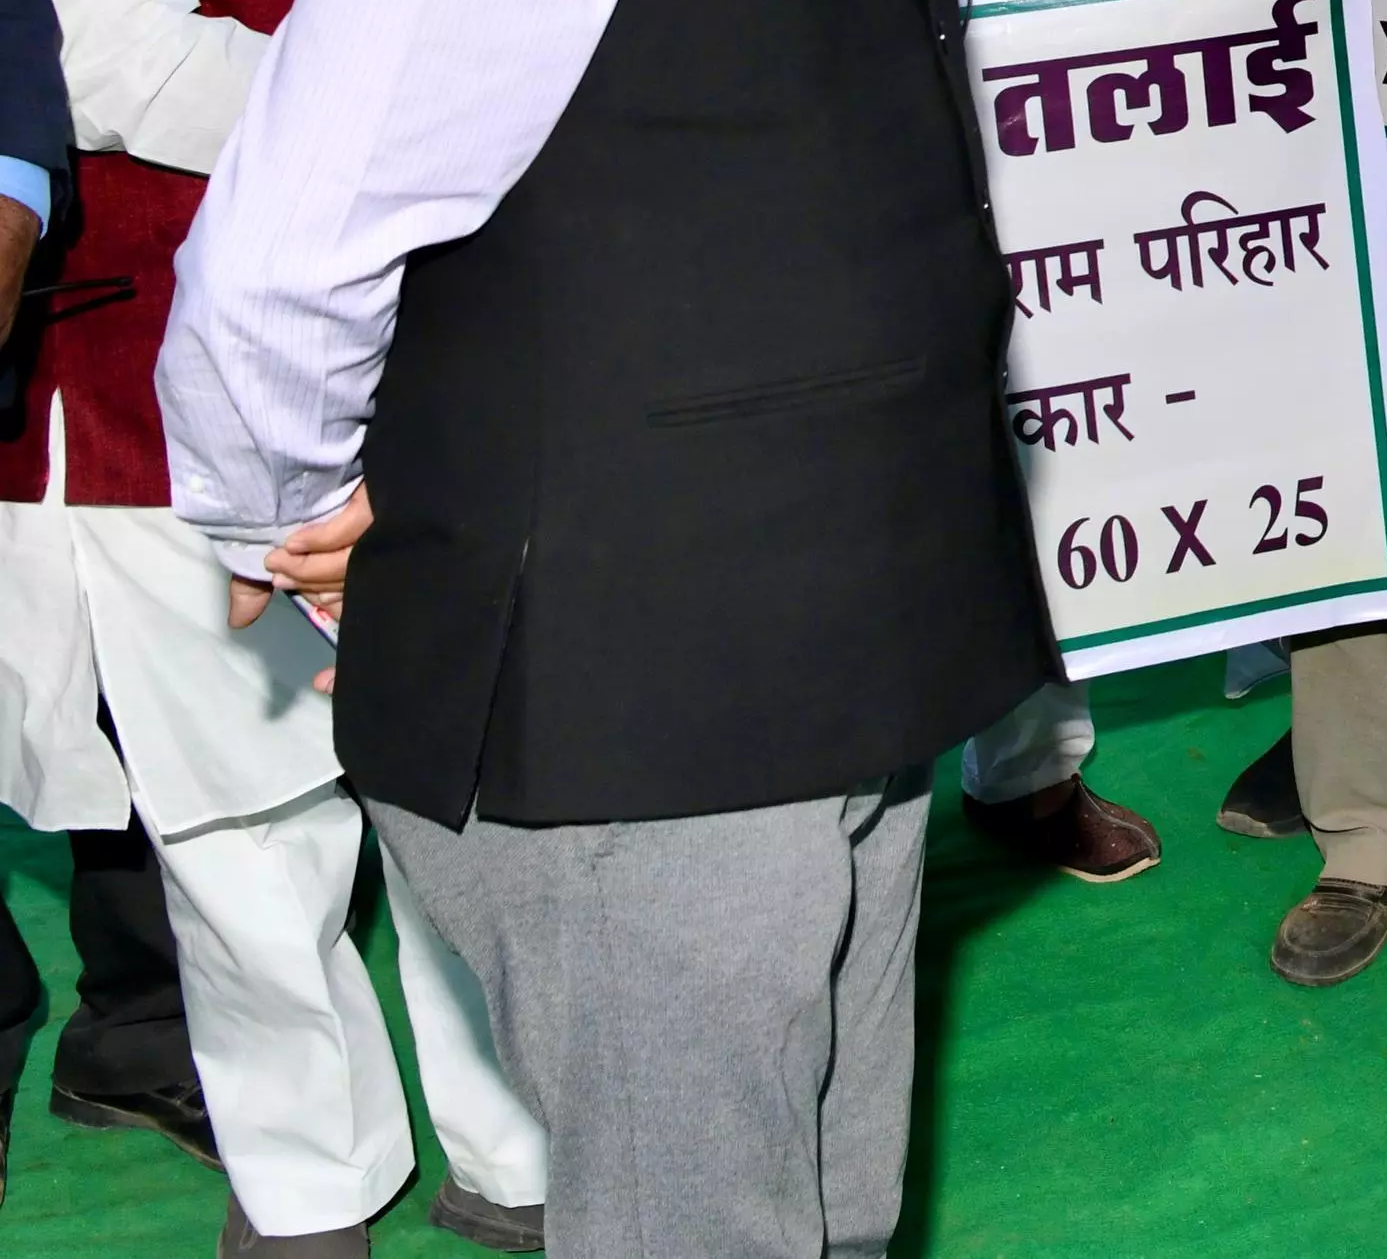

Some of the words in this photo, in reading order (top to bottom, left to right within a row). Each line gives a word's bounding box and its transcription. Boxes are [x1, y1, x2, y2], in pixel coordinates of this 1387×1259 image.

[1134, 191, 1329, 291] परिहार
[1006, 372, 1136, 452] कार
[1058, 515, 1139, 589] 60
[1162, 500, 1216, 573] X
[1249, 476, 1329, 554] 25
